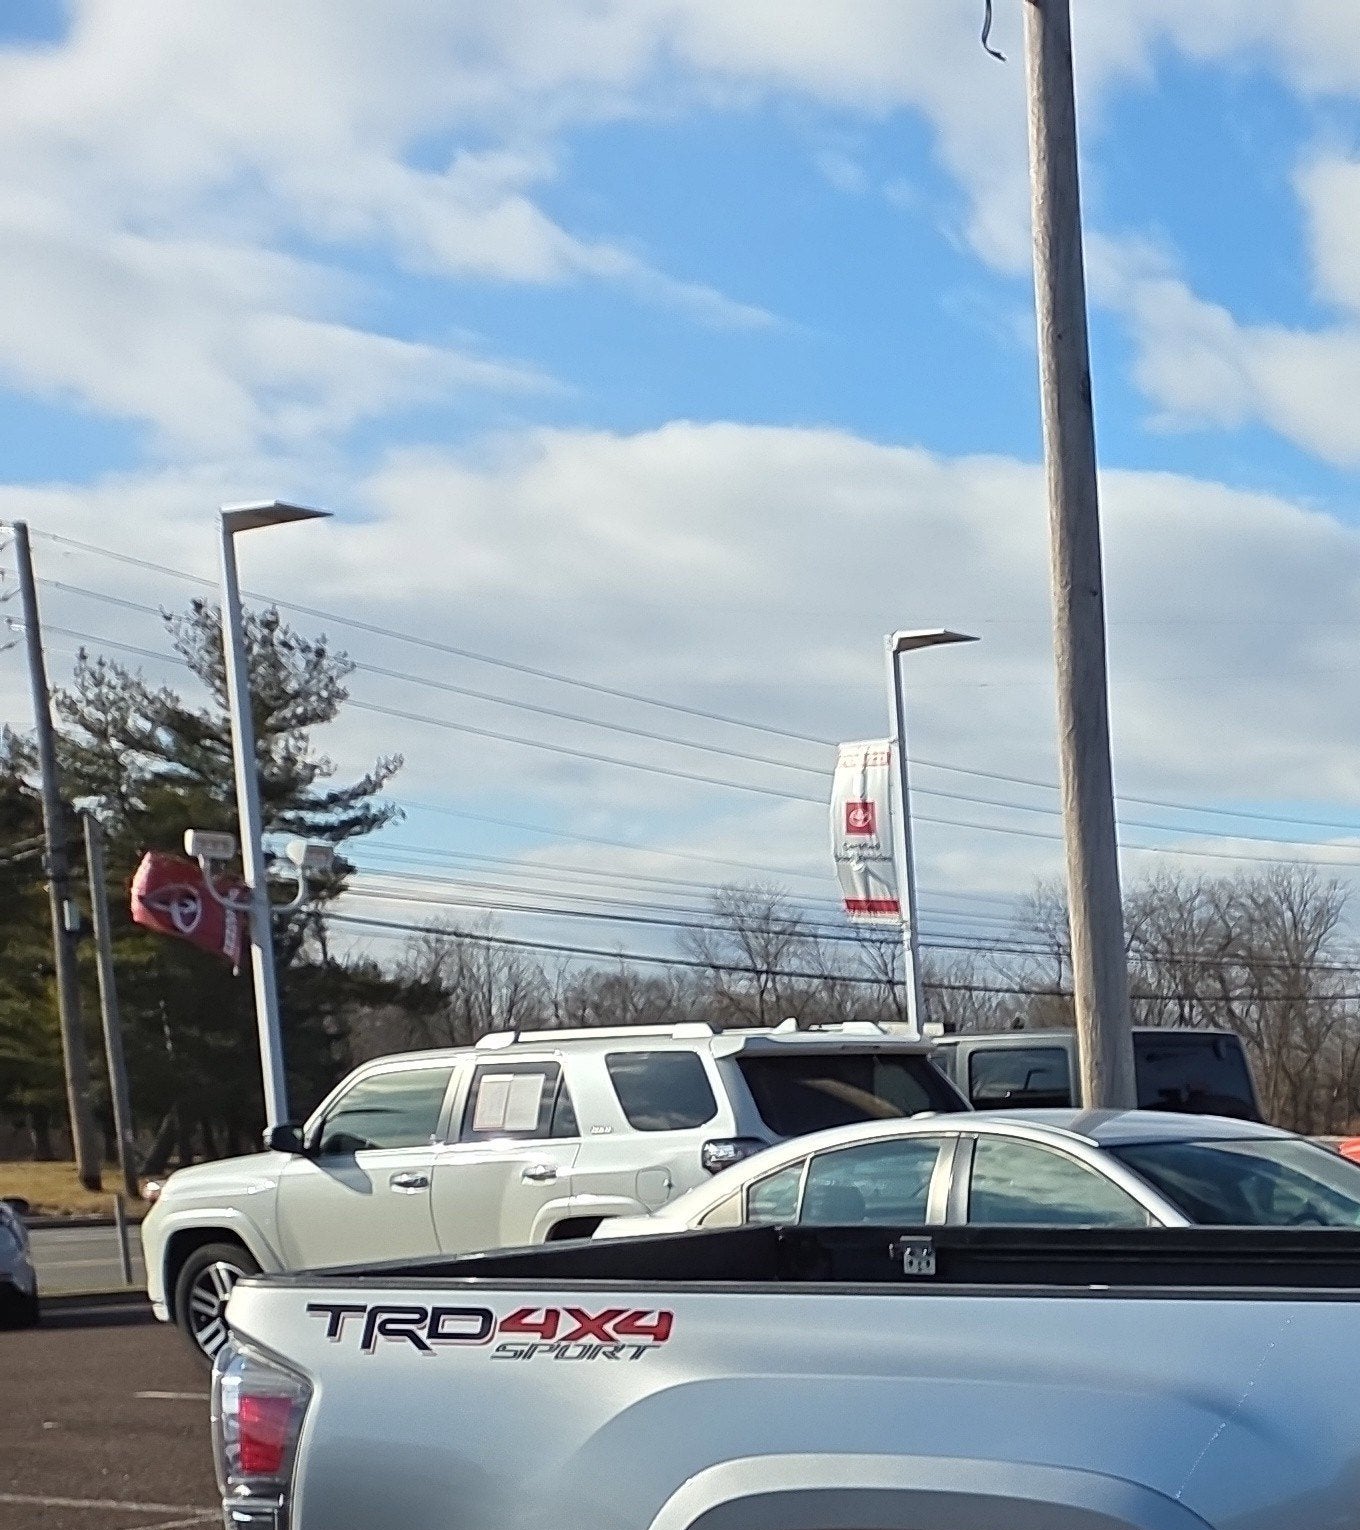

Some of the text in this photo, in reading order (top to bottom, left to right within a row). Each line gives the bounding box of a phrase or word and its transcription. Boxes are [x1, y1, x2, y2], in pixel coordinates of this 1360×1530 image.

[306, 1303, 675, 1355] TRD 4X4
[490, 1342, 664, 1361] SPORT
